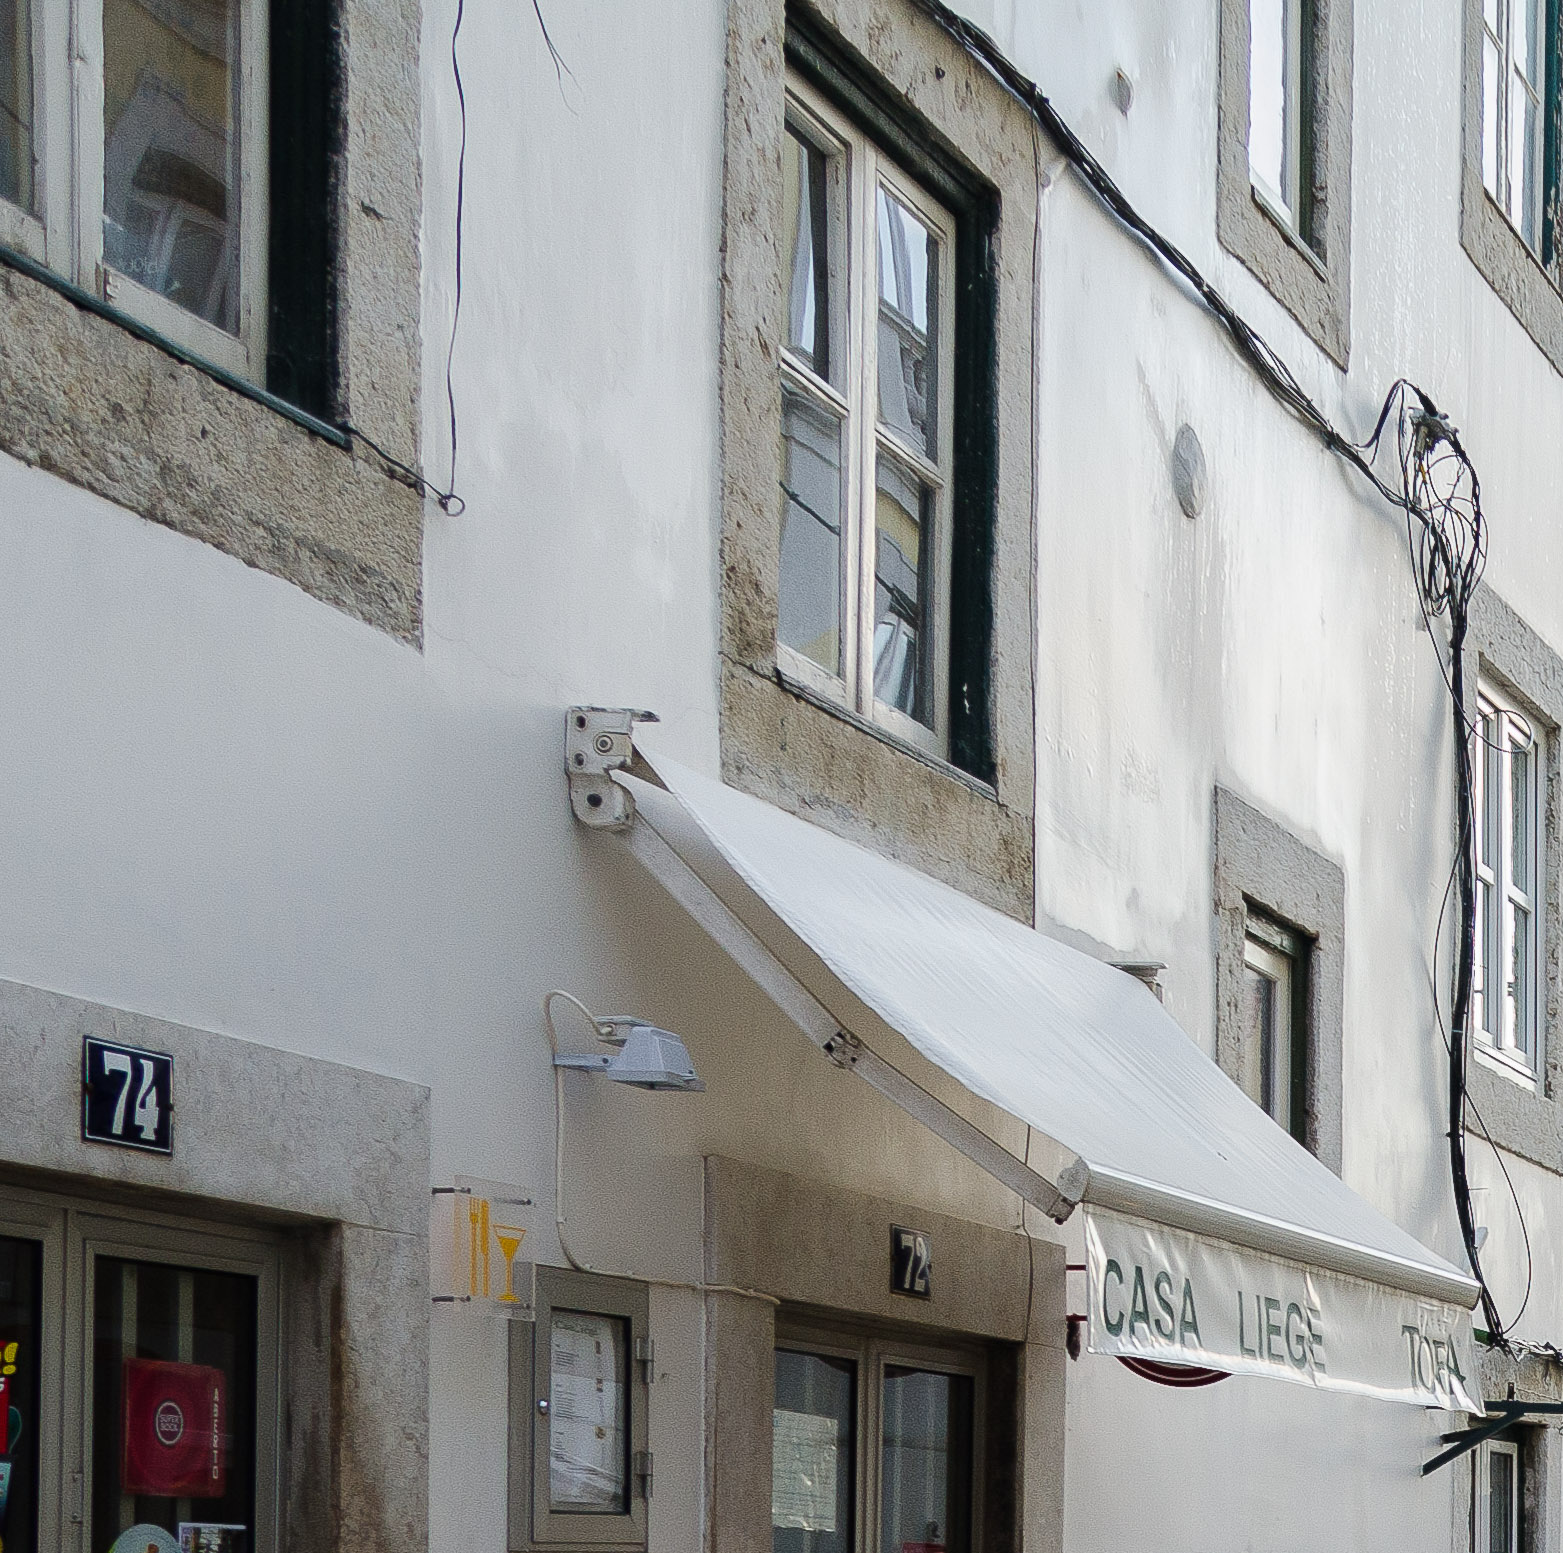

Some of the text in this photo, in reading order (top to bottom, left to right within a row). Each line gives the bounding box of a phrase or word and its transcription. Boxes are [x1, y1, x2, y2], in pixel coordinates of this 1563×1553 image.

[102, 1050, 160, 1141] 74
[900, 1233, 928, 1292] 72
[1102, 1258, 1203, 1349] CASA
[1237, 1290, 1327, 1375] LIEGE
